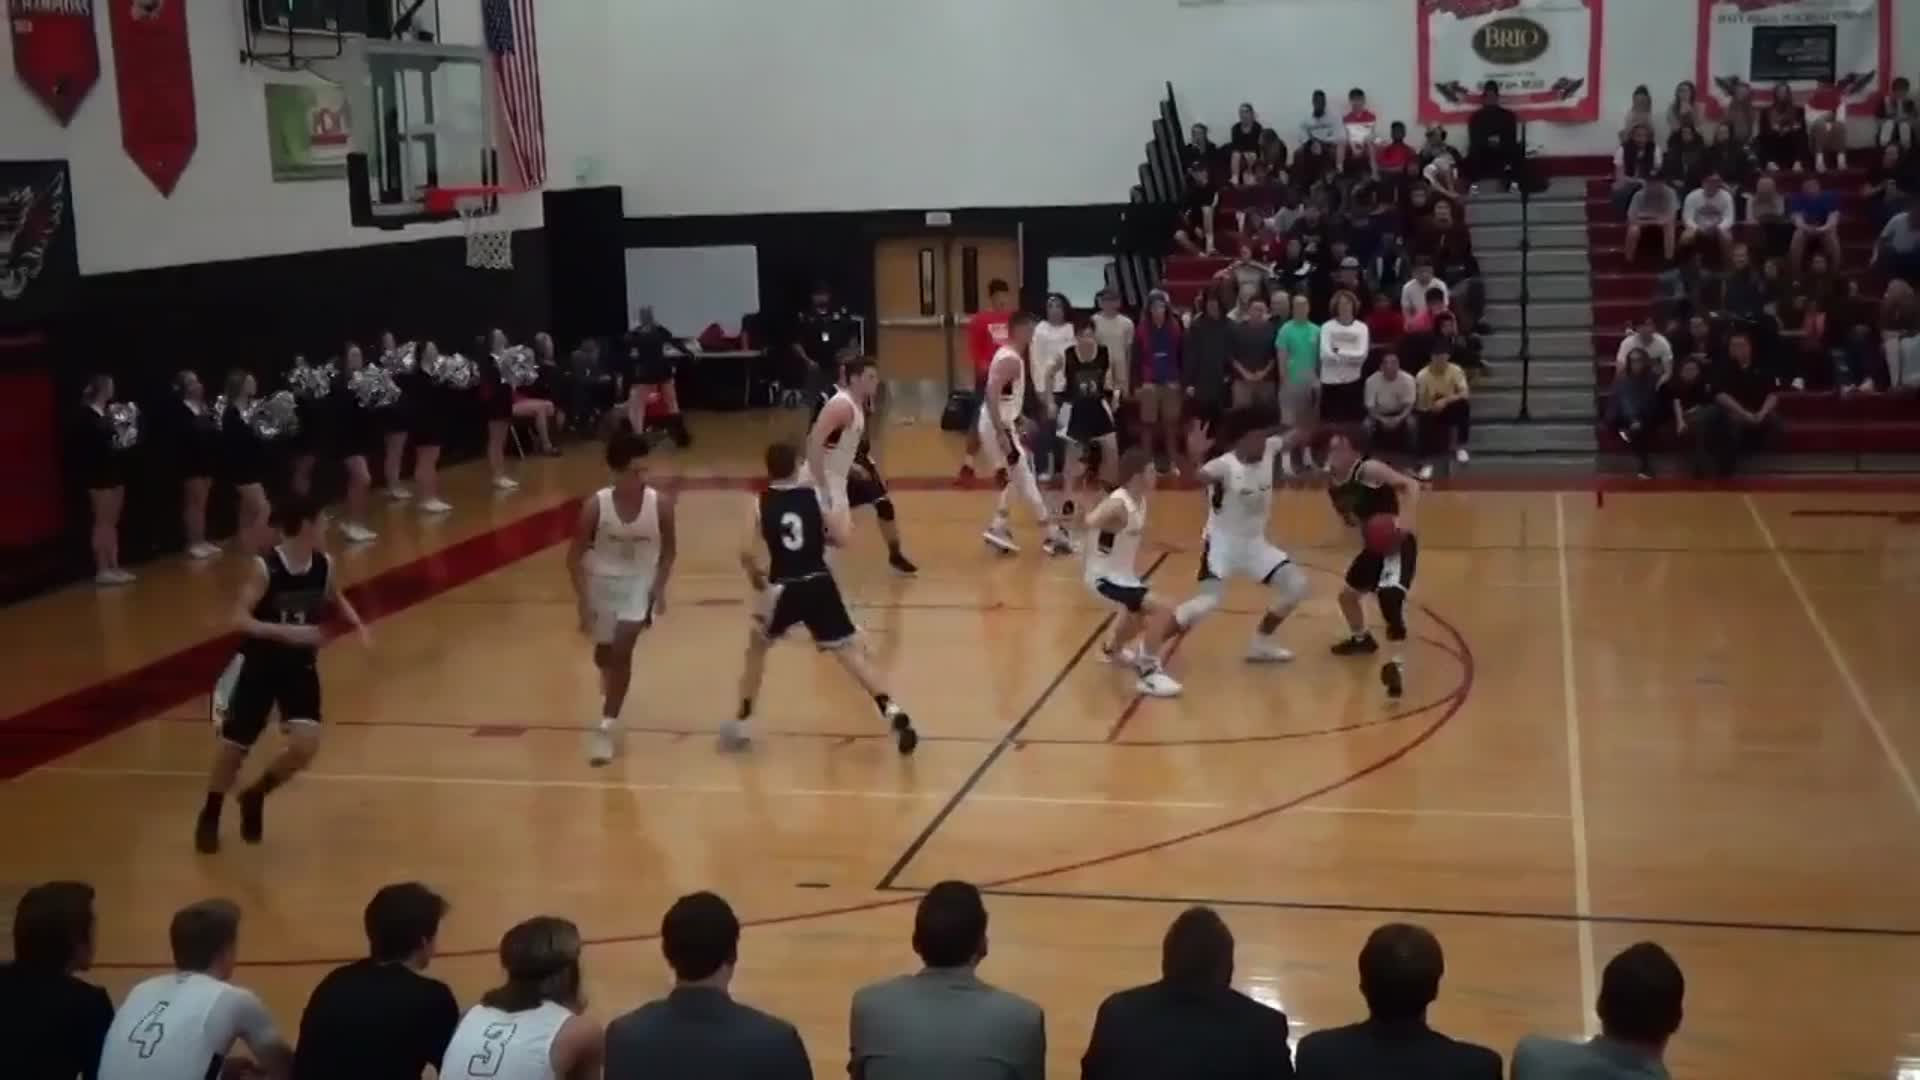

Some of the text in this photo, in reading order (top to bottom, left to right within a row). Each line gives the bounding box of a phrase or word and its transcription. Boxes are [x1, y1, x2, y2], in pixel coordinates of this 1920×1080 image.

[1485, 27, 1539, 48] BRIO
[780, 511, 805, 551] 3
[128, 1000, 171, 1059] 4
[467, 1021, 518, 1078] 3
